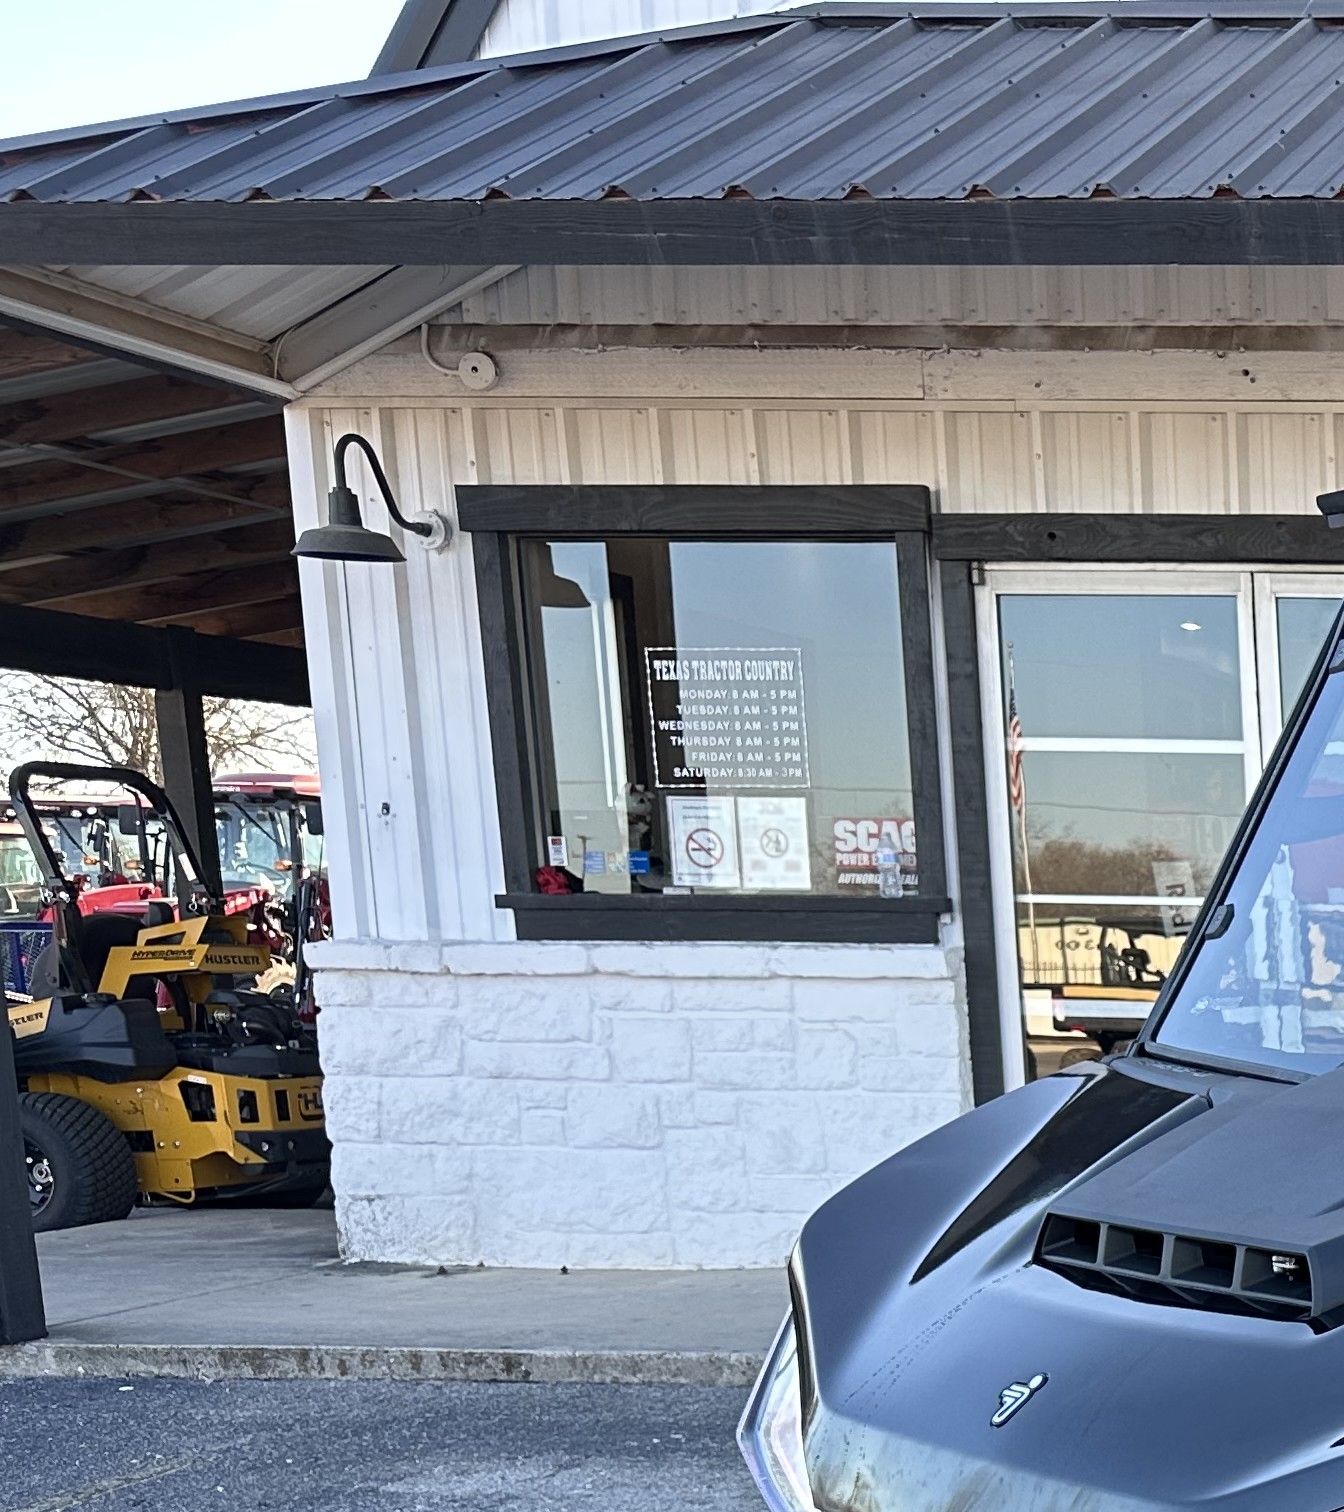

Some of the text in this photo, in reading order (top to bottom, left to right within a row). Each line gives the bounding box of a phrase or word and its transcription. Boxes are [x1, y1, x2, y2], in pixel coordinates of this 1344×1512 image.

[653, 660, 794, 681] TEXAS TRACTOR COUNTRY
[733, 689, 738, 699] 8
[742, 689, 759, 699] AM
[770, 689, 777, 699] 5
[780, 689, 796, 699] PM
[734, 705, 740, 715] 8
[744, 705, 760, 715] AM
[772, 705, 777, 715] 5
[782, 705, 797, 715] PM
[735, 721, 741, 730] 8
[744, 721, 761, 730] AM
[773, 721, 779, 730] 5
[783, 721, 799, 730] PM
[736, 736, 742, 746] 8
[746, 736, 762, 746] AM
[774, 736, 780, 746] 5
[784, 736, 800, 746] PM
[737, 752, 743, 762] 8
[747, 752, 763, 762] AM
[774, 752, 781, 762] 5
[785, 752, 801, 762] PM
[738, 767, 757, 777] 8:30
[759, 767, 772, 777] AM
[782, 767, 788, 777] 3
[789, 767, 802, 777] PM
[836, 853, 870, 866] POWER
[206, 955, 260, 965] HUSTLER
